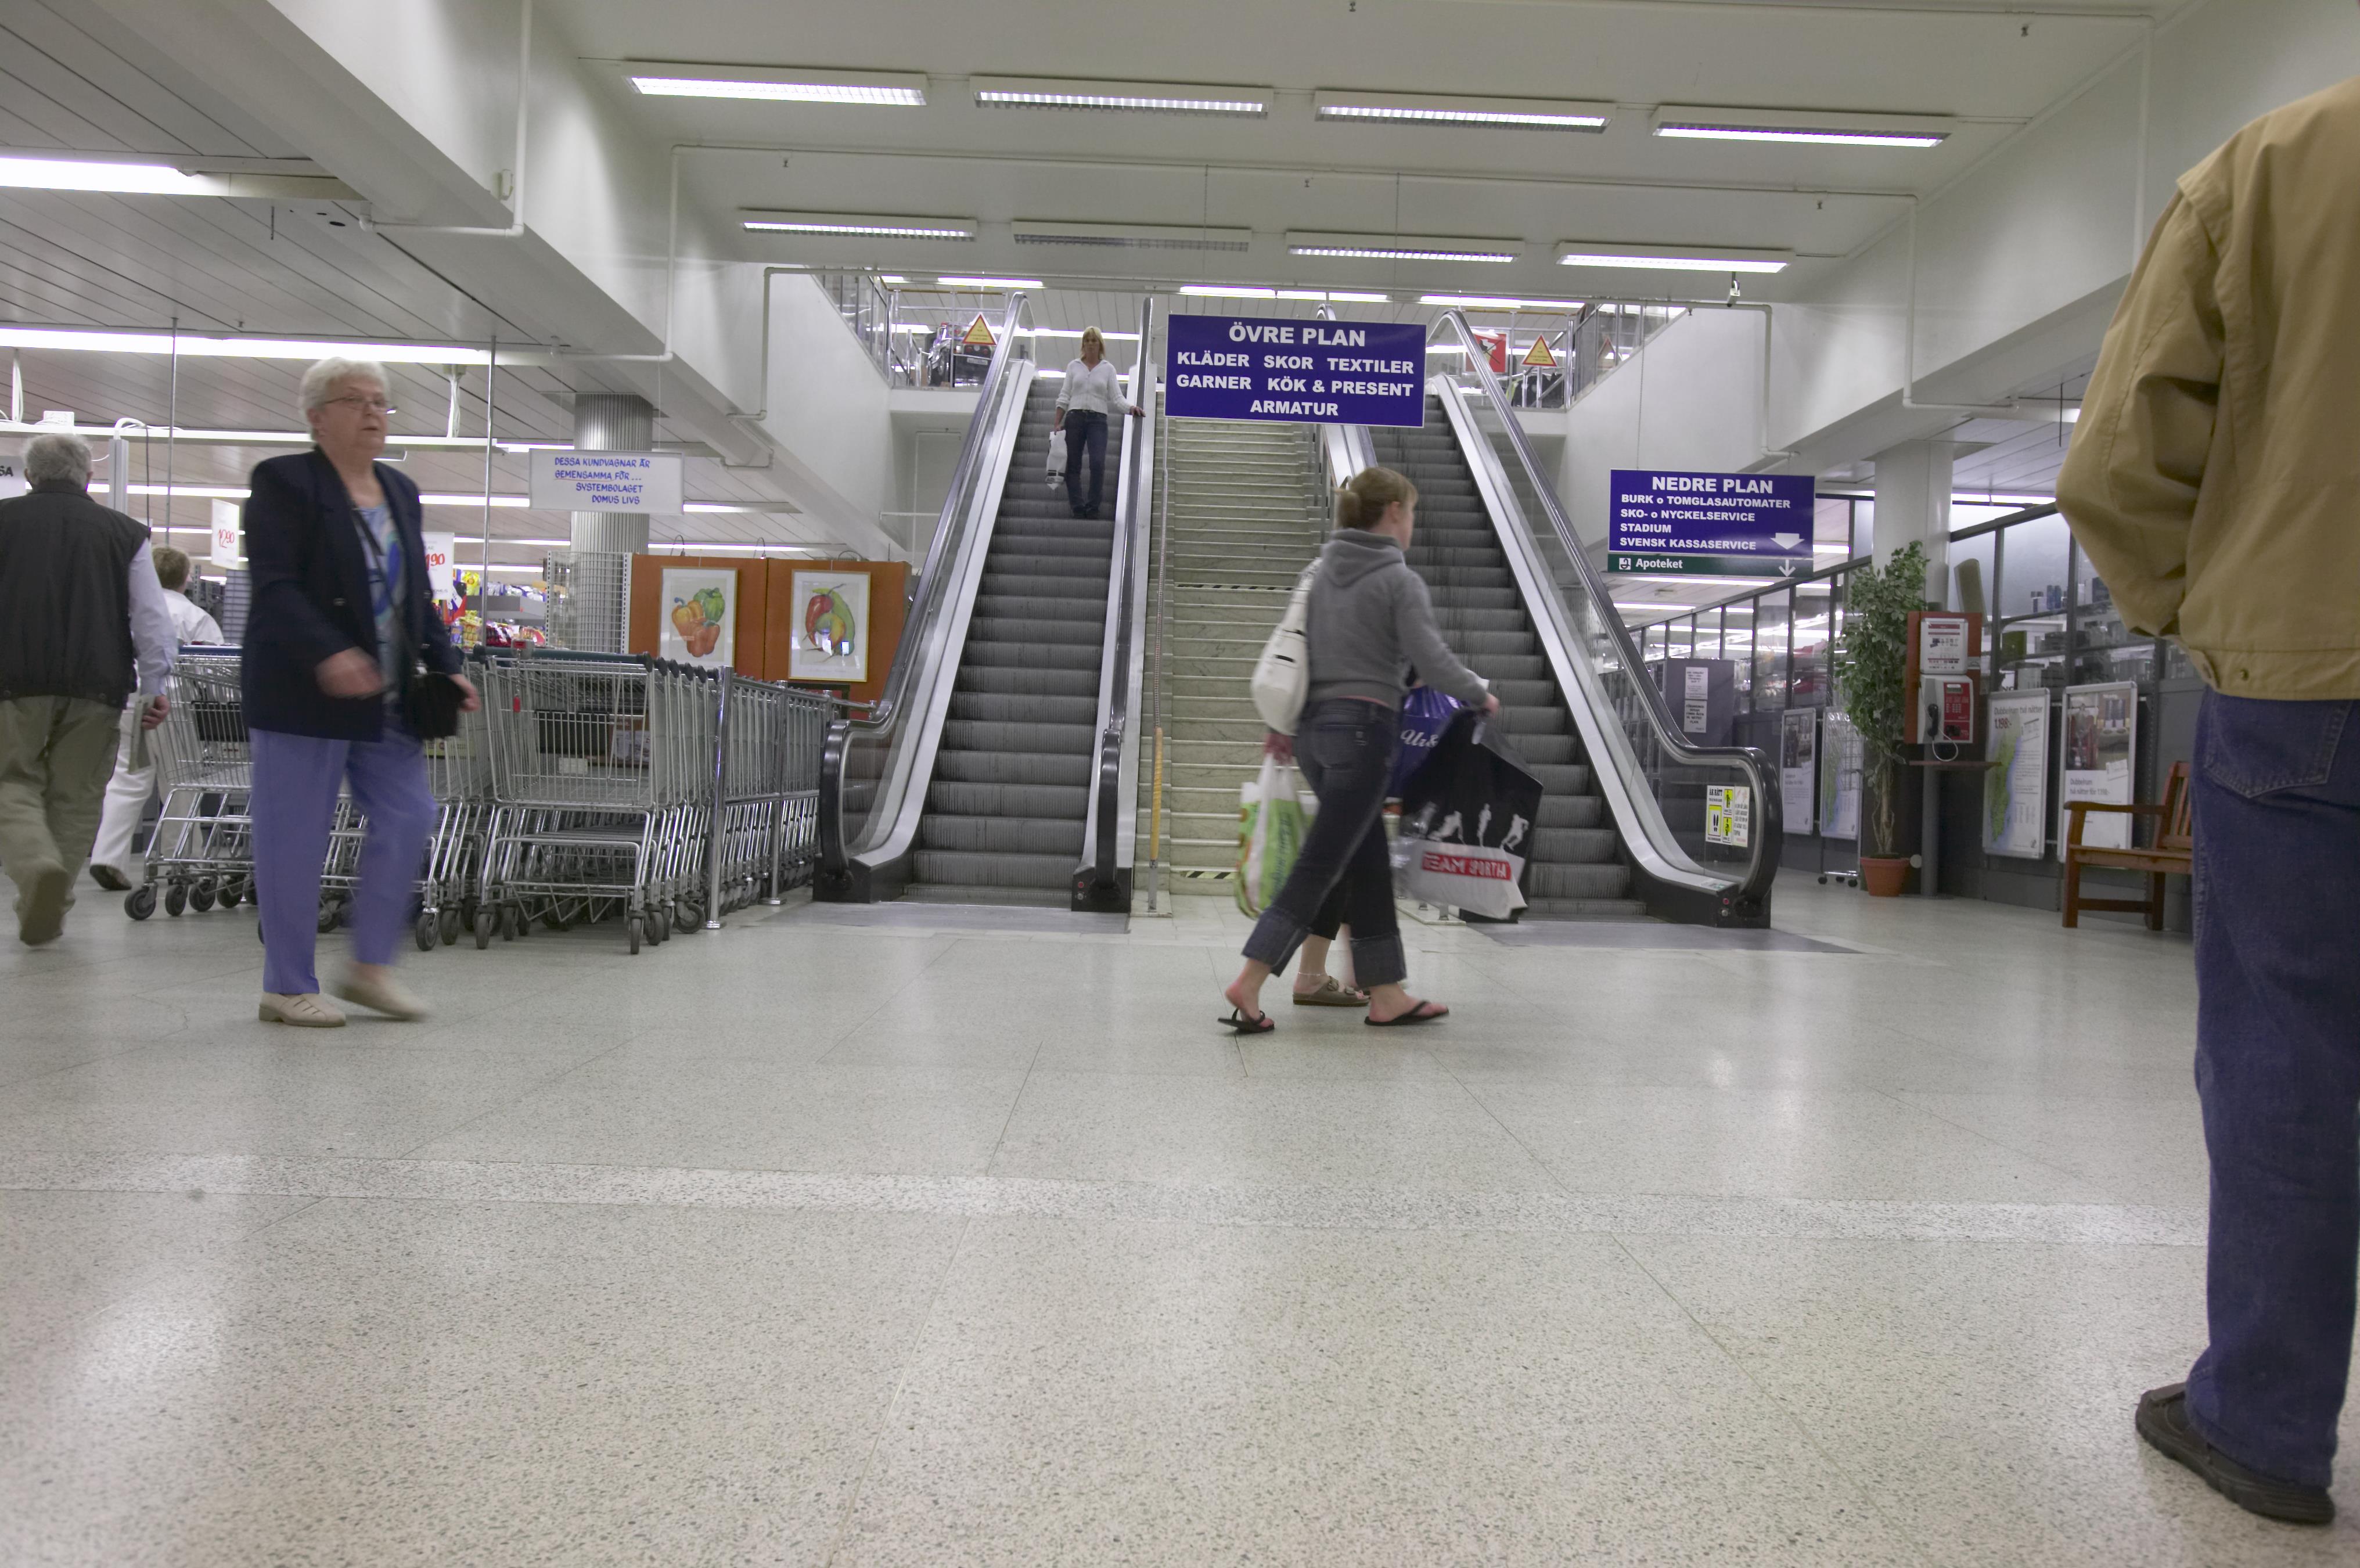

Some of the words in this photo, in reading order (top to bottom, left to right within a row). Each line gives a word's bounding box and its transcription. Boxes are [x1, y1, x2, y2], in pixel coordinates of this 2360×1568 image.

[1229, 322, 1294, 344] ÖVRE
[1303, 328, 1366, 347] PLAN
[1177, 350, 1250, 367] KLÄDER
[1264, 355, 1314, 370] SKOR
[1328, 358, 1414, 374] TEXTILER
[1177, 374, 1252, 390] GARNER
[1268, 376, 1307, 392] KÖK
[1312, 380, 1325, 393] &
[1332, 381, 1413, 397] PRESENT
[1250, 400, 1339, 416] ARMATUR
[555, 457, 580, 466] DESSA
[582, 458, 636, 468] KUNDVAGNAR
[639, 458, 650, 469] ÄR
[555, 470, 612, 480] GEMENSAMMA
[614, 470, 629, 481] FÖR
[576, 482, 643, 494] SYSTEMBOLAGET
[1652, 476, 1717, 492] NEDRE
[1723, 479, 1773, 494] PLAN
[592, 495, 620, 504] DOMUS
[622, 495, 640, 505] LIVS
[1621, 494, 1653, 504] BURK
[1667, 495, 1791, 509] TOMGLASAUTOMATER
[1620, 509, 1648, 518] SKO-
[1661, 510, 1755, 522] NYCKELSERVICE
[1620, 523, 1671, 533] STADIUM
[1620, 537, 1667, 548] SVENSK
[1670, 539, 1756, 551] KASSASERVICE
[1635, 558, 1683, 570] Apoteket
